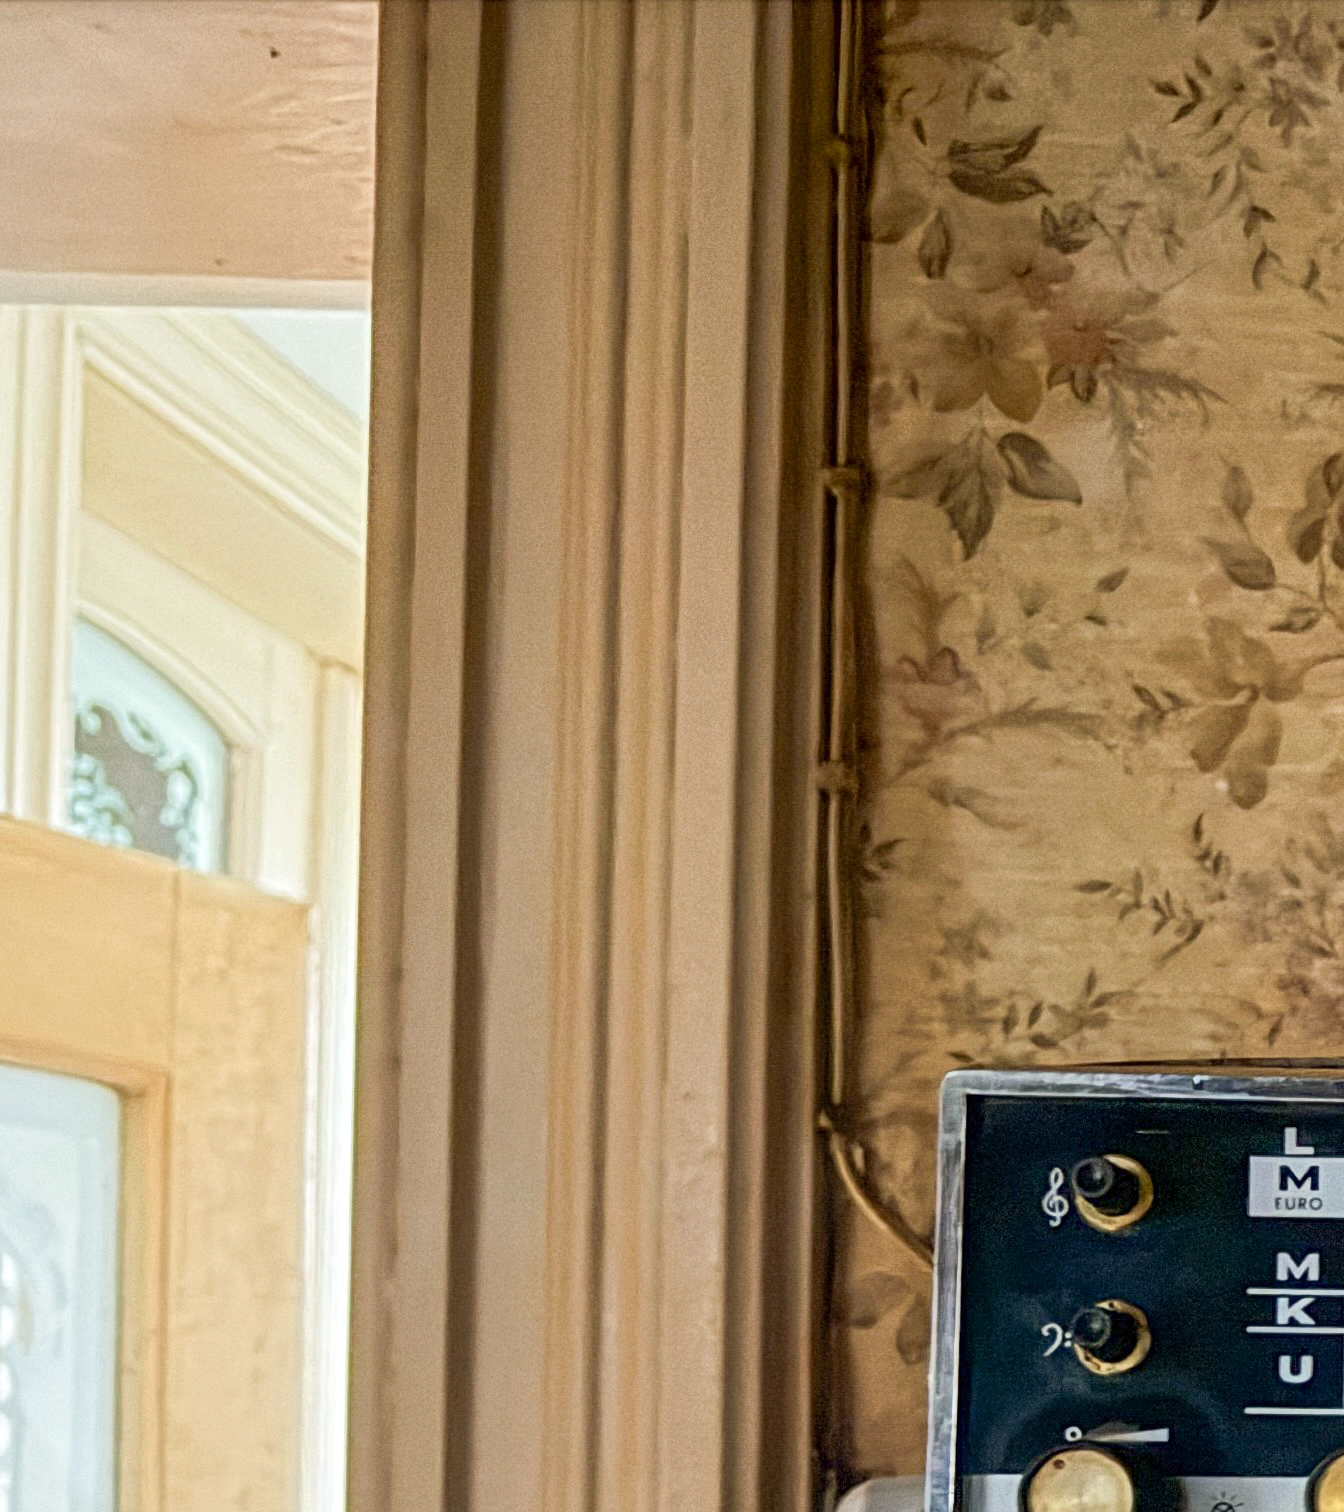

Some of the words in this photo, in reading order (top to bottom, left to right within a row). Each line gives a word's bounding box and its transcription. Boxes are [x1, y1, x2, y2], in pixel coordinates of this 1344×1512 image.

[1284, 1127, 1315, 1154] L
[1279, 1165, 1320, 1192] M
[1274, 1196, 1324, 1212] EURO
[1276, 1252, 1320, 1282] M
[1276, 1297, 1317, 1326] K
[1279, 1355, 1314, 1384] U
